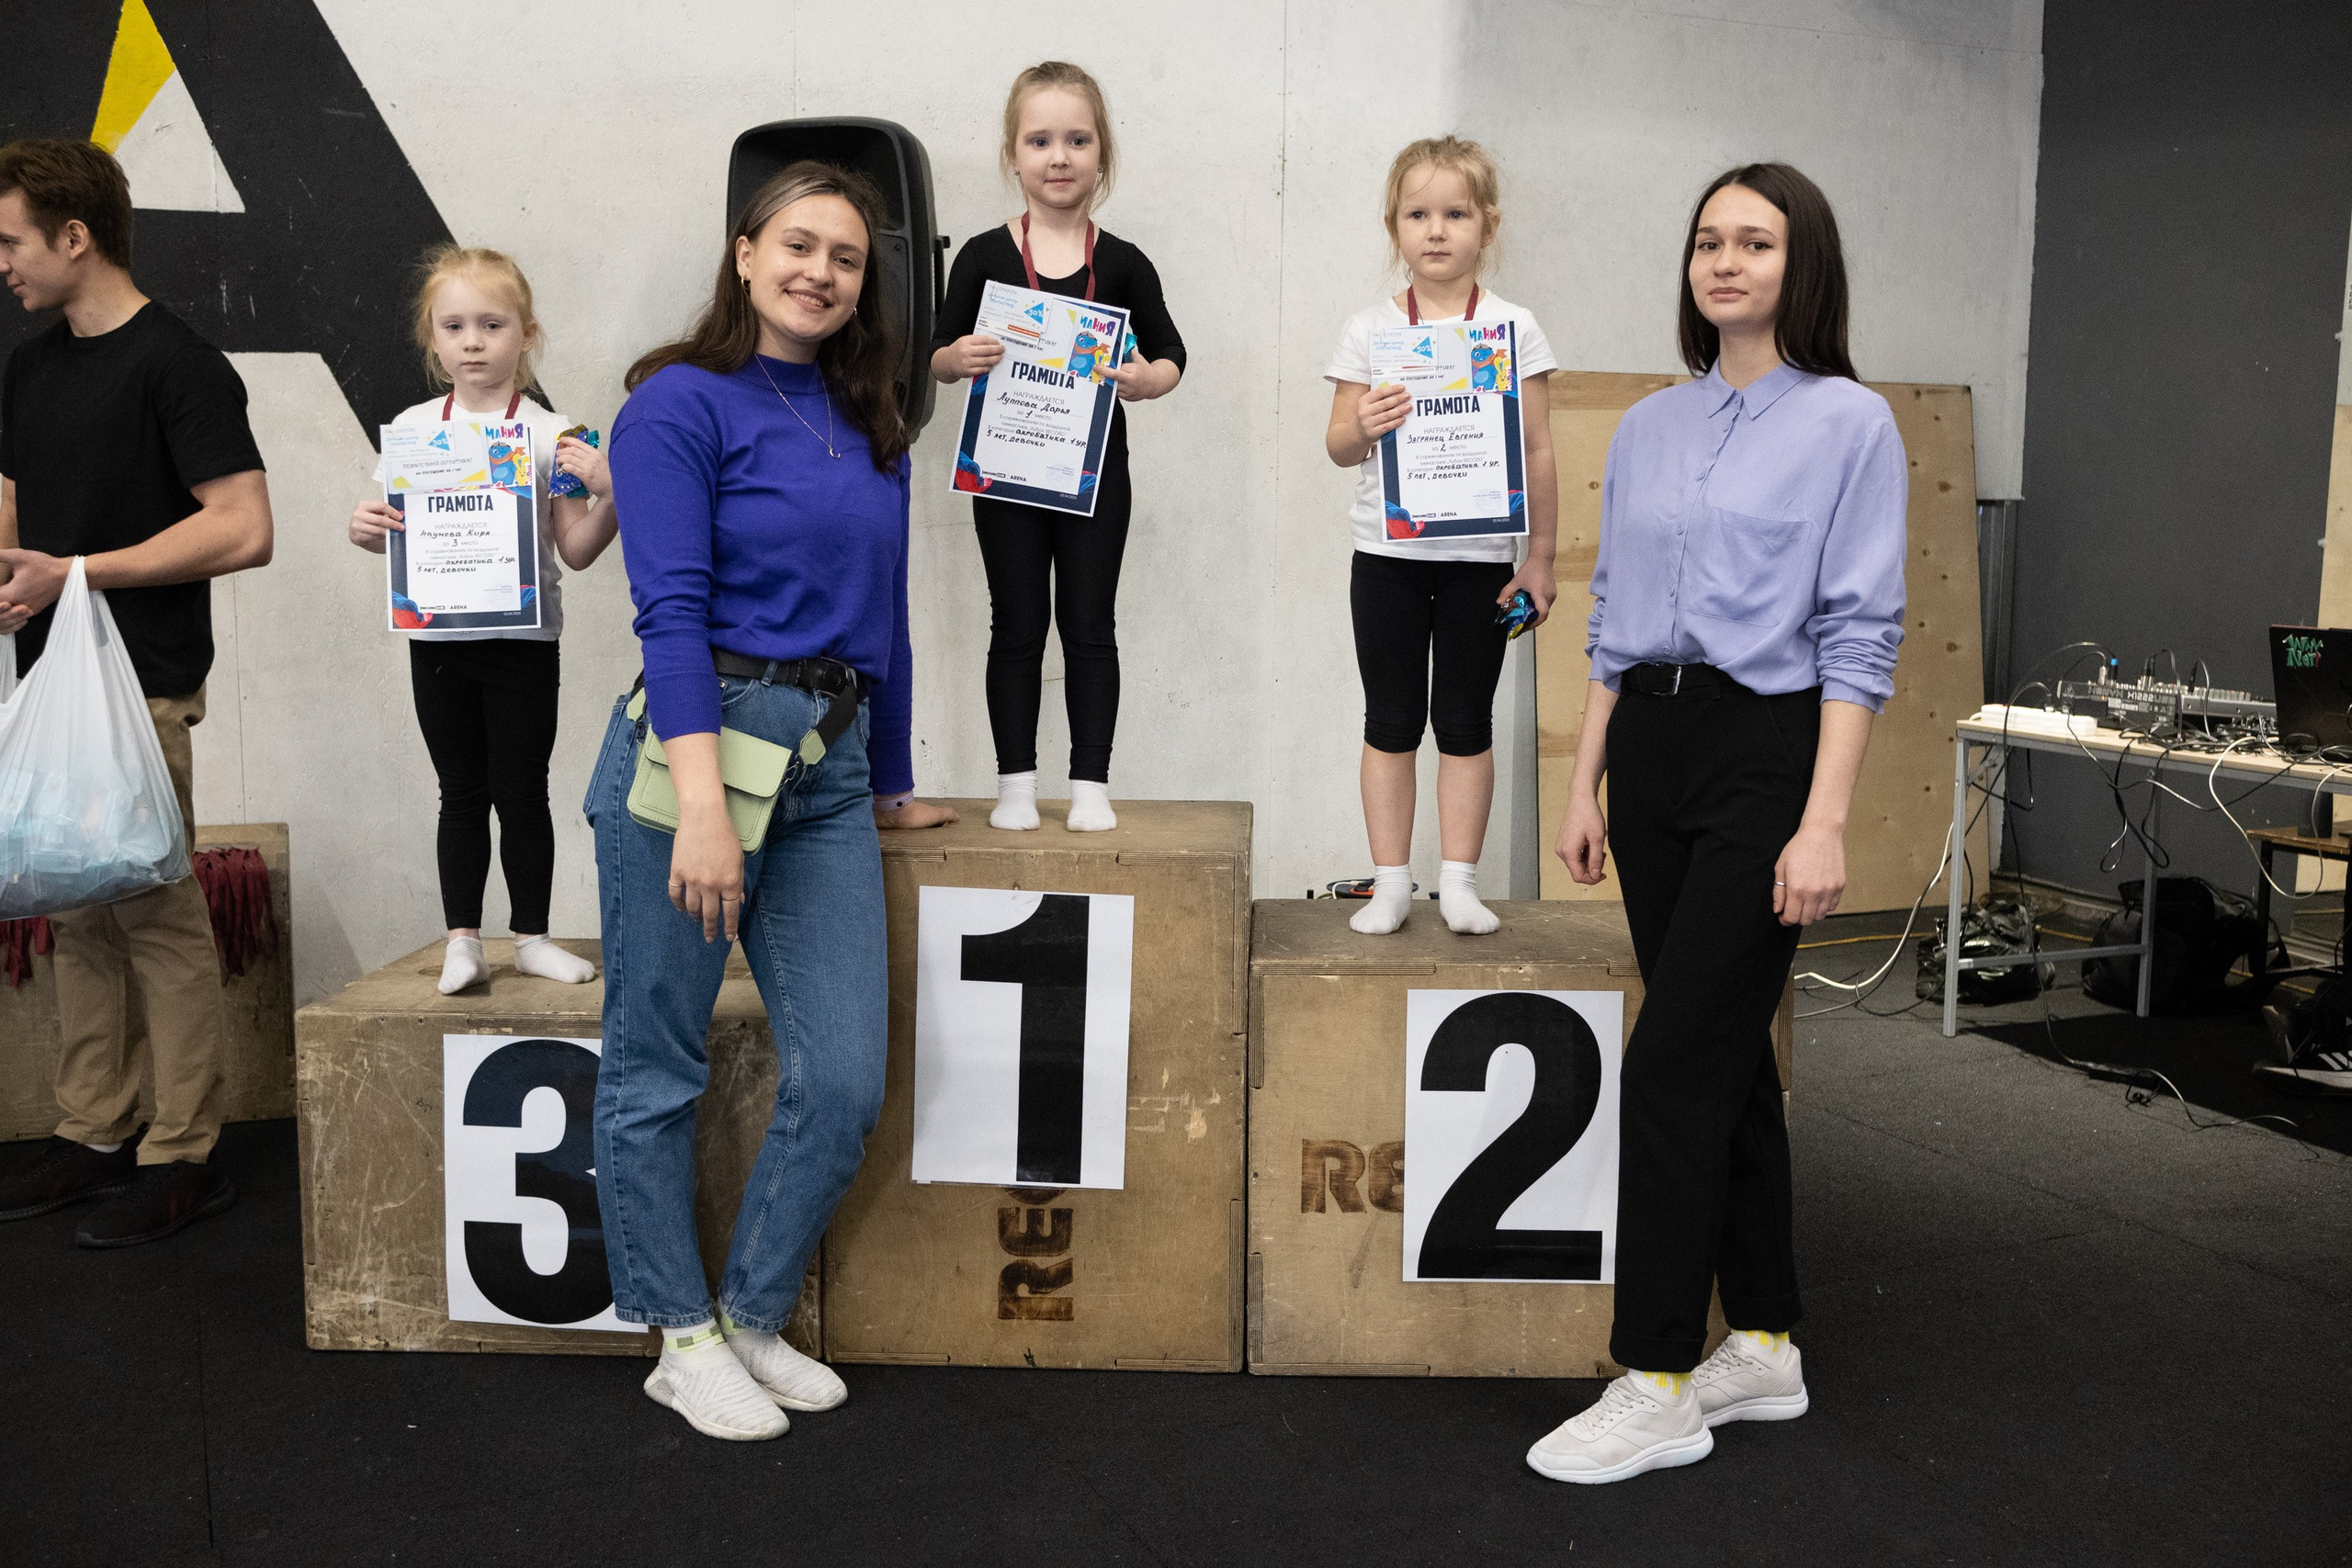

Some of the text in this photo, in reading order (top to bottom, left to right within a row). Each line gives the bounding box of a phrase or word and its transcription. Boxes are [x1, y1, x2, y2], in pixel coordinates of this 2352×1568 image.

[1028, 309, 1044, 318] 30%
[1011, 361, 1076, 389] ГРАМОТА
[997, 391, 1070, 414] Луппова Дарья
[1013, 390, 1065, 405] НАГРАЖДАЕТСЯ
[1416, 395, 1481, 417] ГРАМОТА
[1424, 424, 1475, 434] НАГРАЖДАЕТСЯ
[1009, 436, 1046, 447] девочки
[1449, 432, 1484, 441] Евгения
[1440, 444, 1447, 452] 2
[1407, 471, 1413, 479] 5
[427, 494, 494, 513] ГРАМОТА
[435, 522, 488, 530] НАГРАЖДАЕТСЯ
[420, 530, 462, 538] Наумова
[451, 538, 458, 547] 3
[961, 894, 1090, 1185] 1
[1417, 992, 1603, 1281] 2
[463, 1039, 616, 1325] 3
[998, 1188, 1074, 1321] RE
